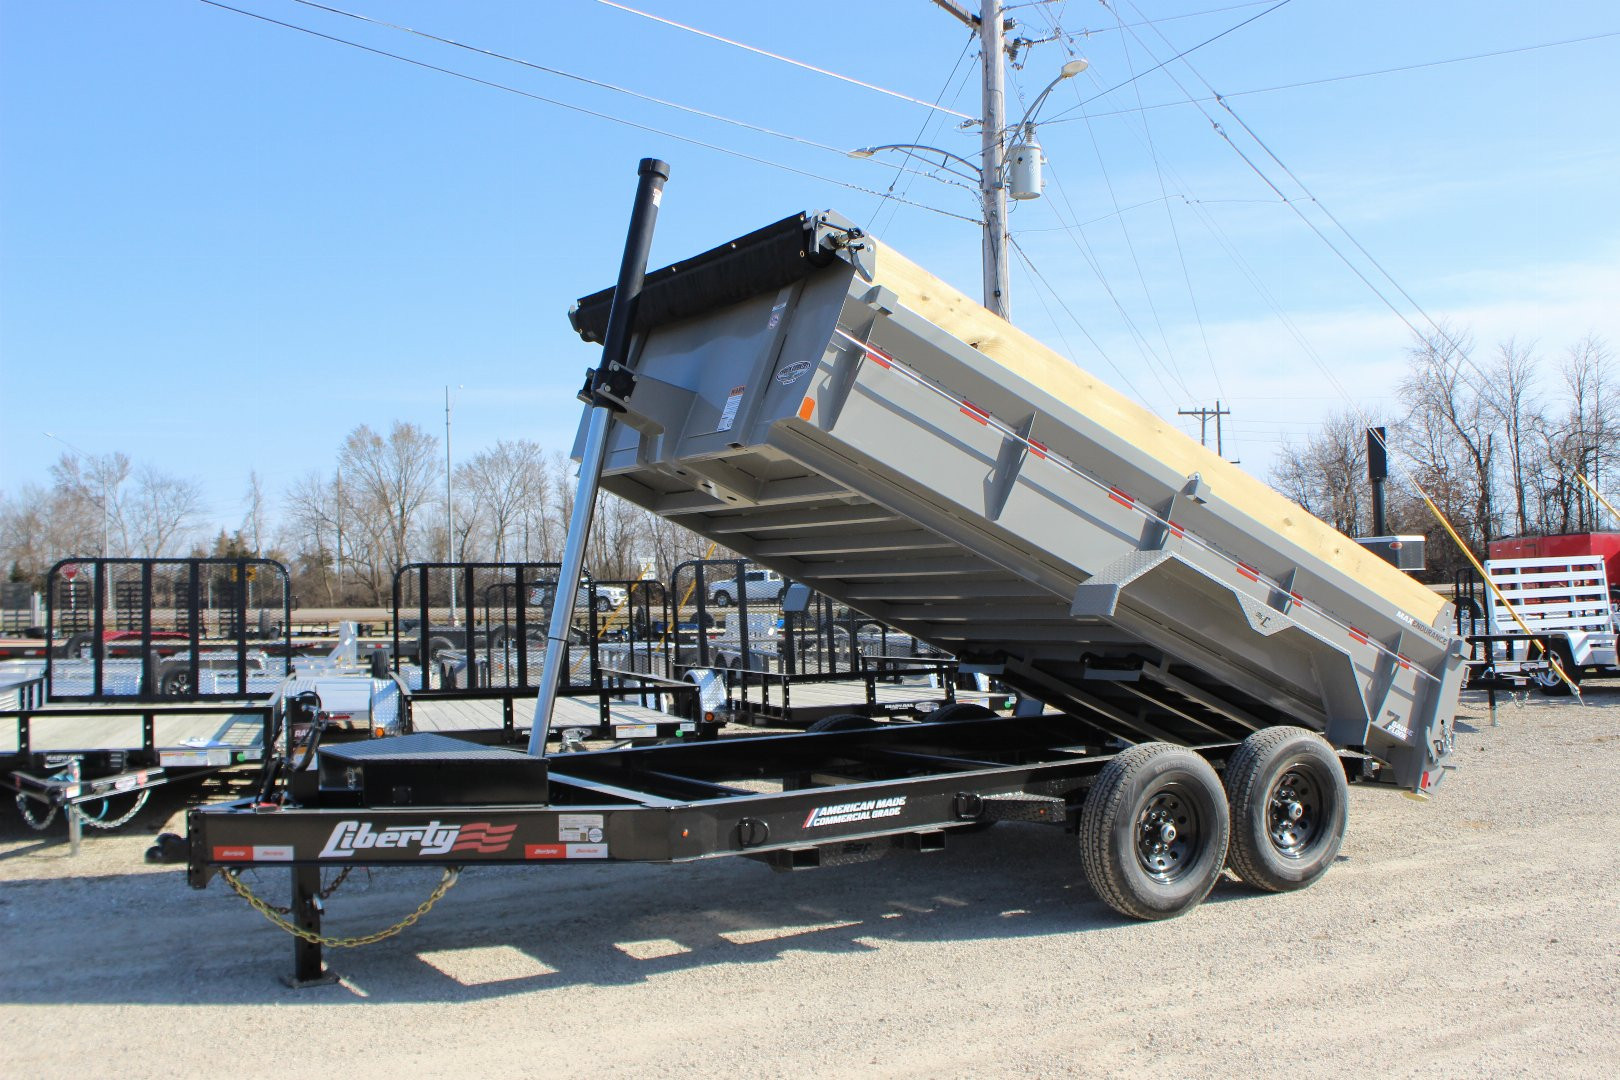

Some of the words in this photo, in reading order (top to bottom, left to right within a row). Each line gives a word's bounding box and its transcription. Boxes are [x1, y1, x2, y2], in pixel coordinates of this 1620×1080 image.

[1387, 710, 1401, 729] 7
[819, 801, 876, 817] AMERICAN
[876, 796, 908, 809] MADE
[813, 812, 871, 827] COMMERCIAL
[871, 807, 902, 819] GRADE
[318, 820, 461, 859] Liberty
